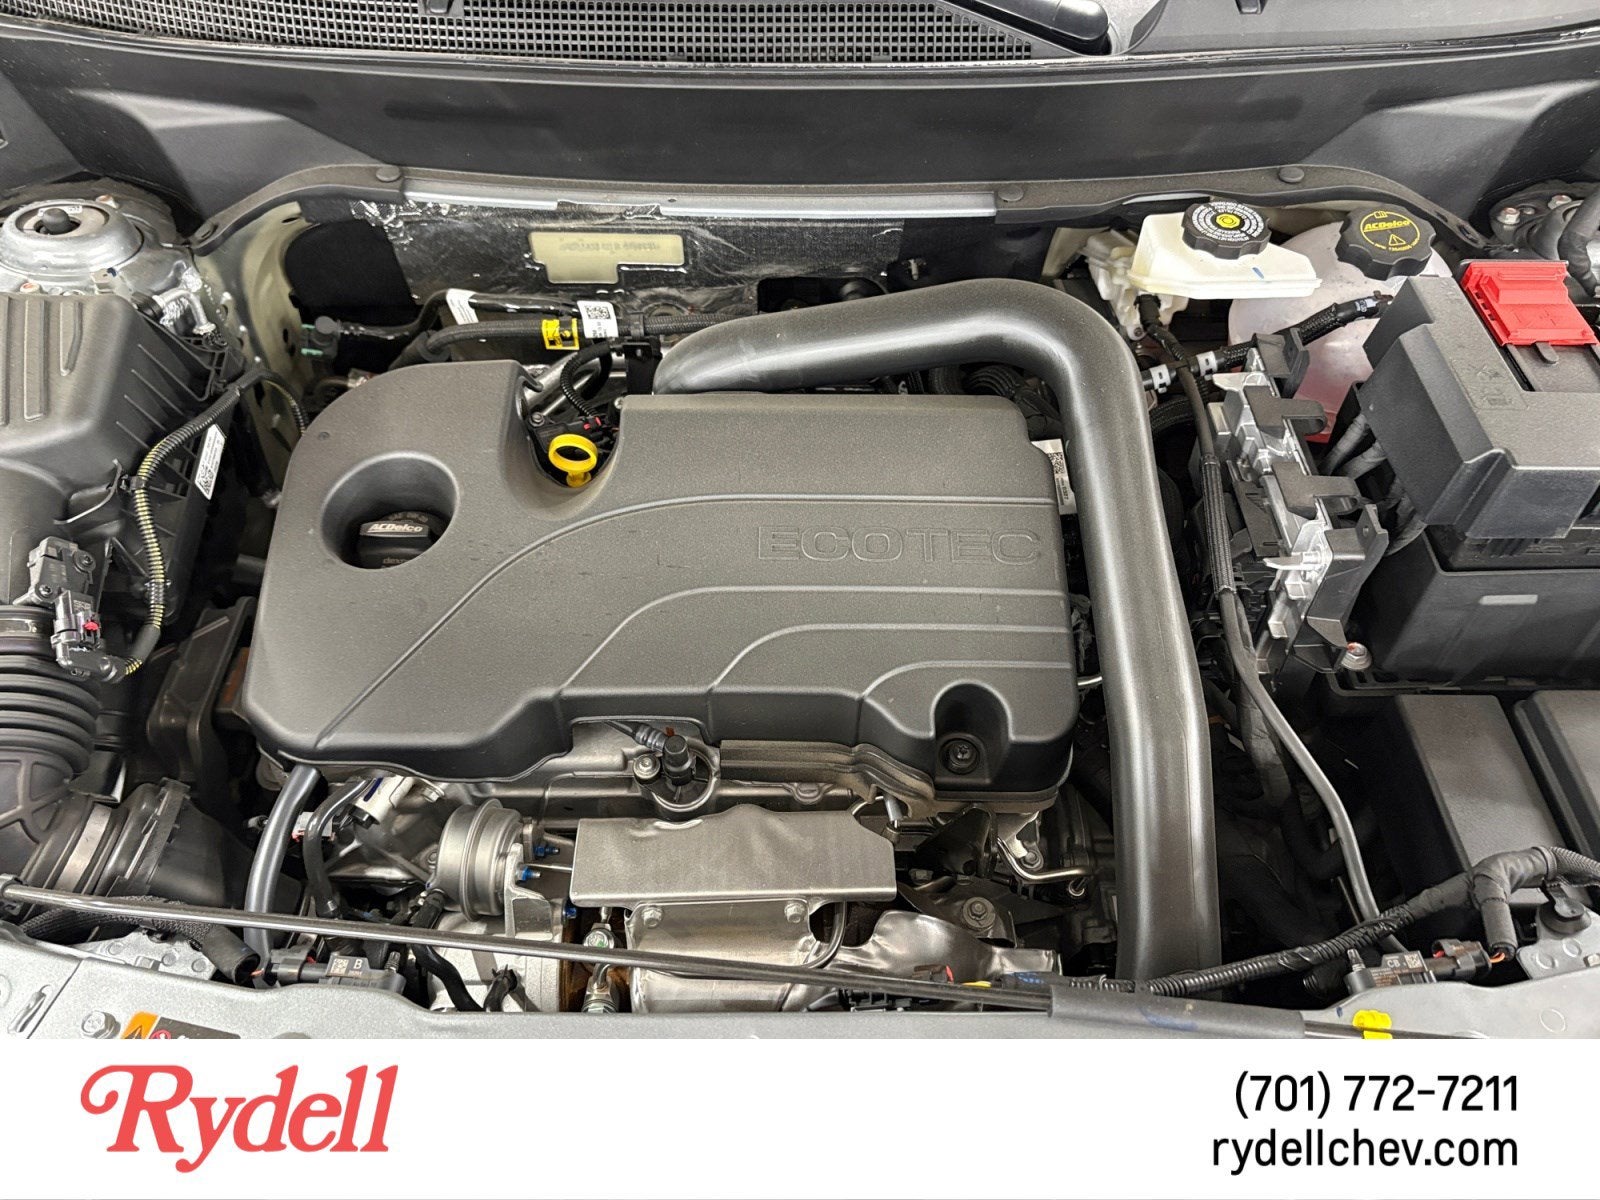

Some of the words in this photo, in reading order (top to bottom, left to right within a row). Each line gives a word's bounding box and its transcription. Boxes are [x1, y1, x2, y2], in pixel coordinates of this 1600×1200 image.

[1363, 220, 1410, 232] ACDelco
[368, 523, 423, 533] ACDelco
[758, 526, 1042, 565] ECOTEC
[354, 959, 363, 969] B
